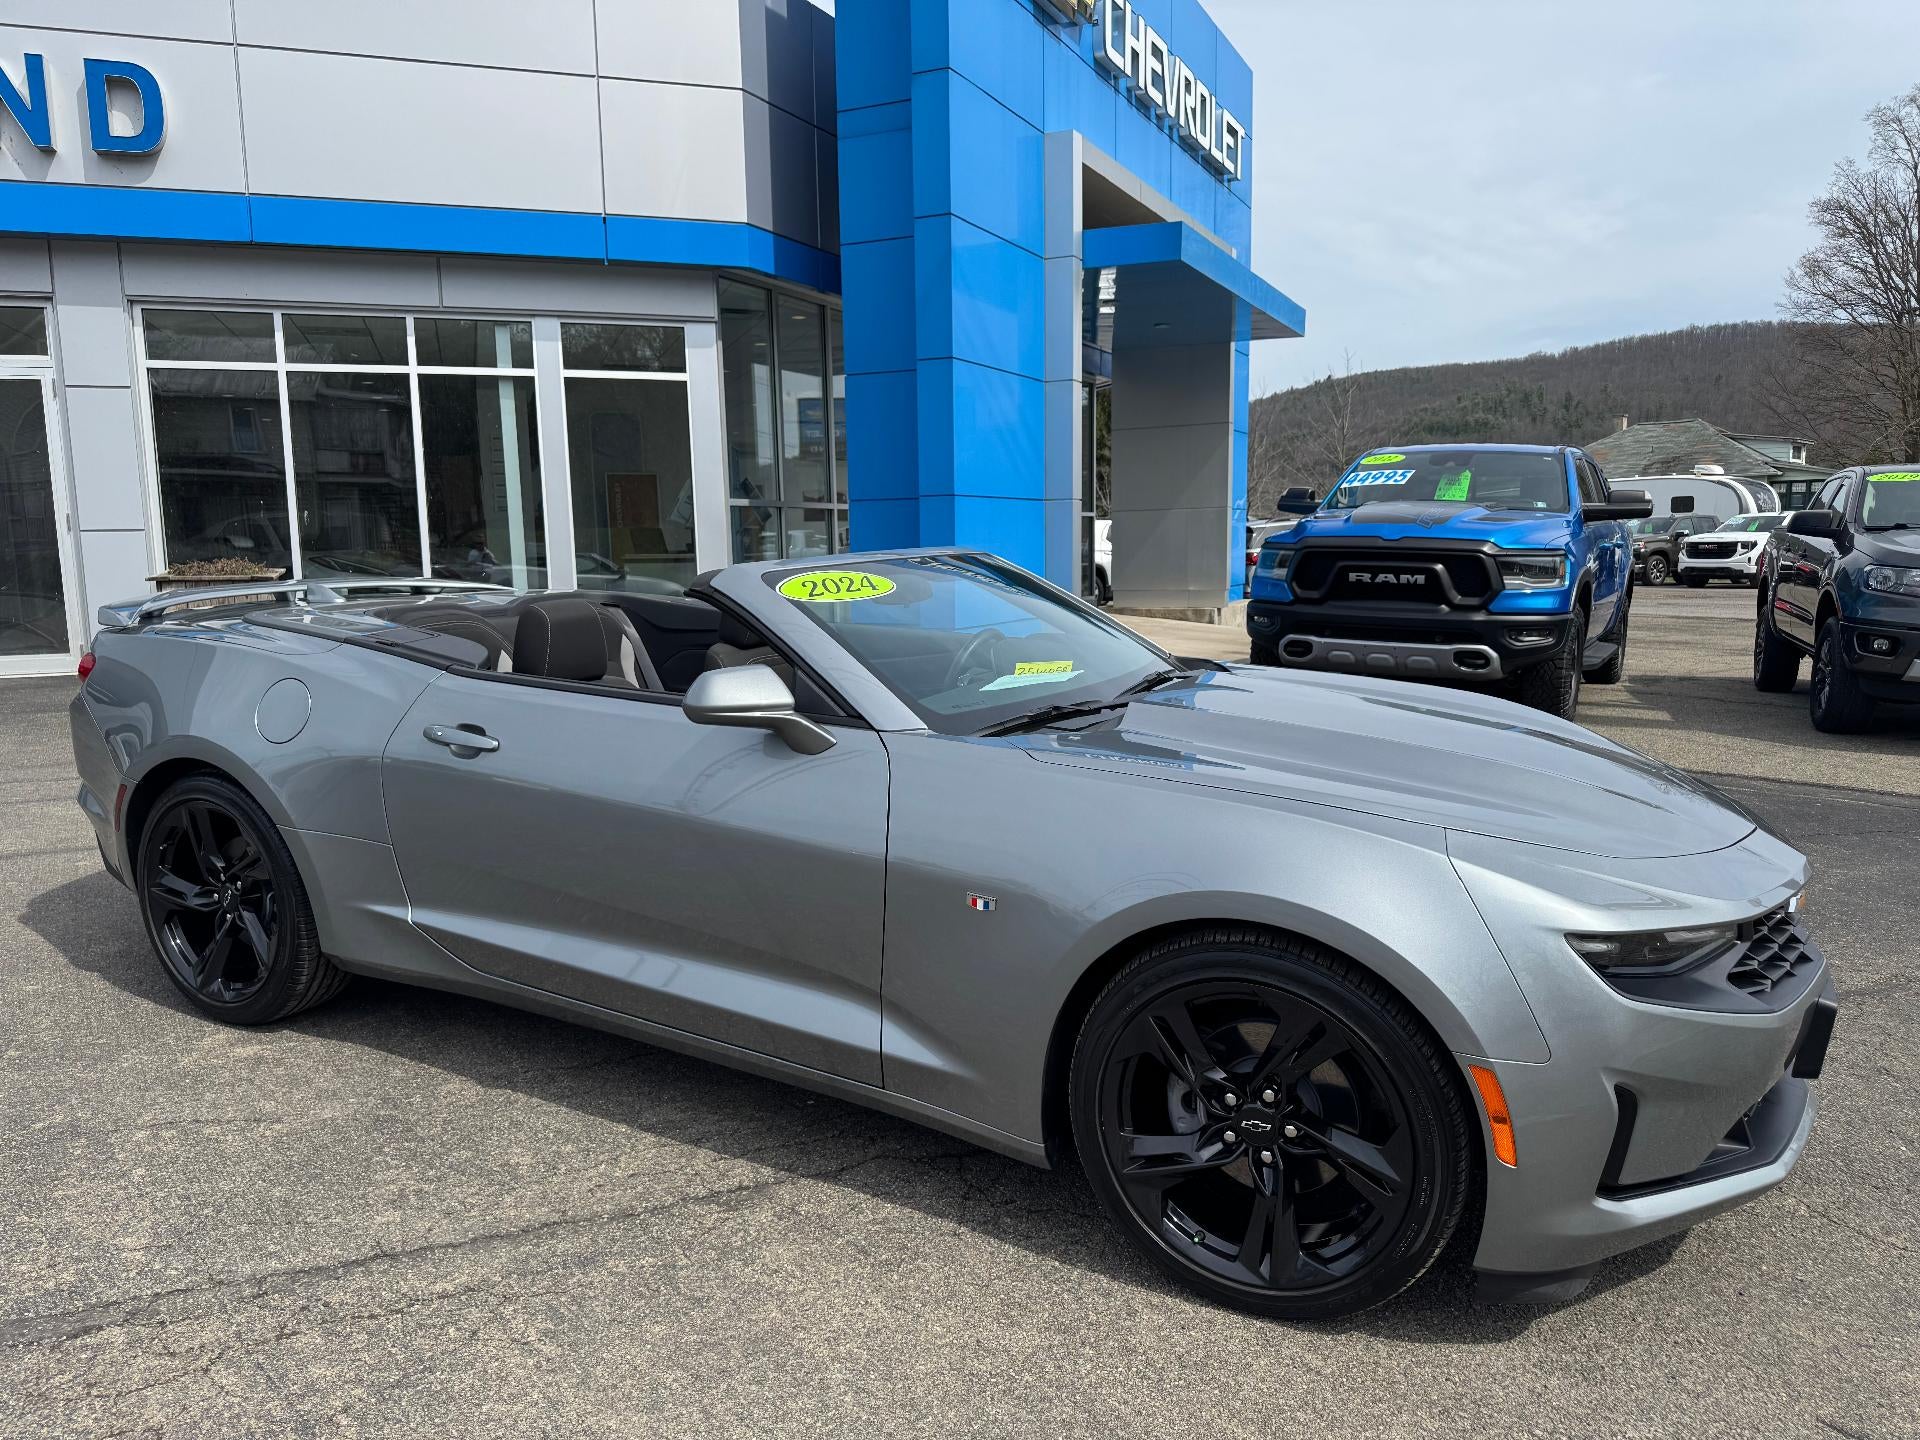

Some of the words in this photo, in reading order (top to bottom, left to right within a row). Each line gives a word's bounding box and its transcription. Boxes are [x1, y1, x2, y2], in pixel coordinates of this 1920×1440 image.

[1104, 0, 1245, 181] CHEVROLET
[1344, 470, 1413, 486] 44995
[801, 575, 880, 598] 2024
[1348, 572, 1426, 584] RAM
